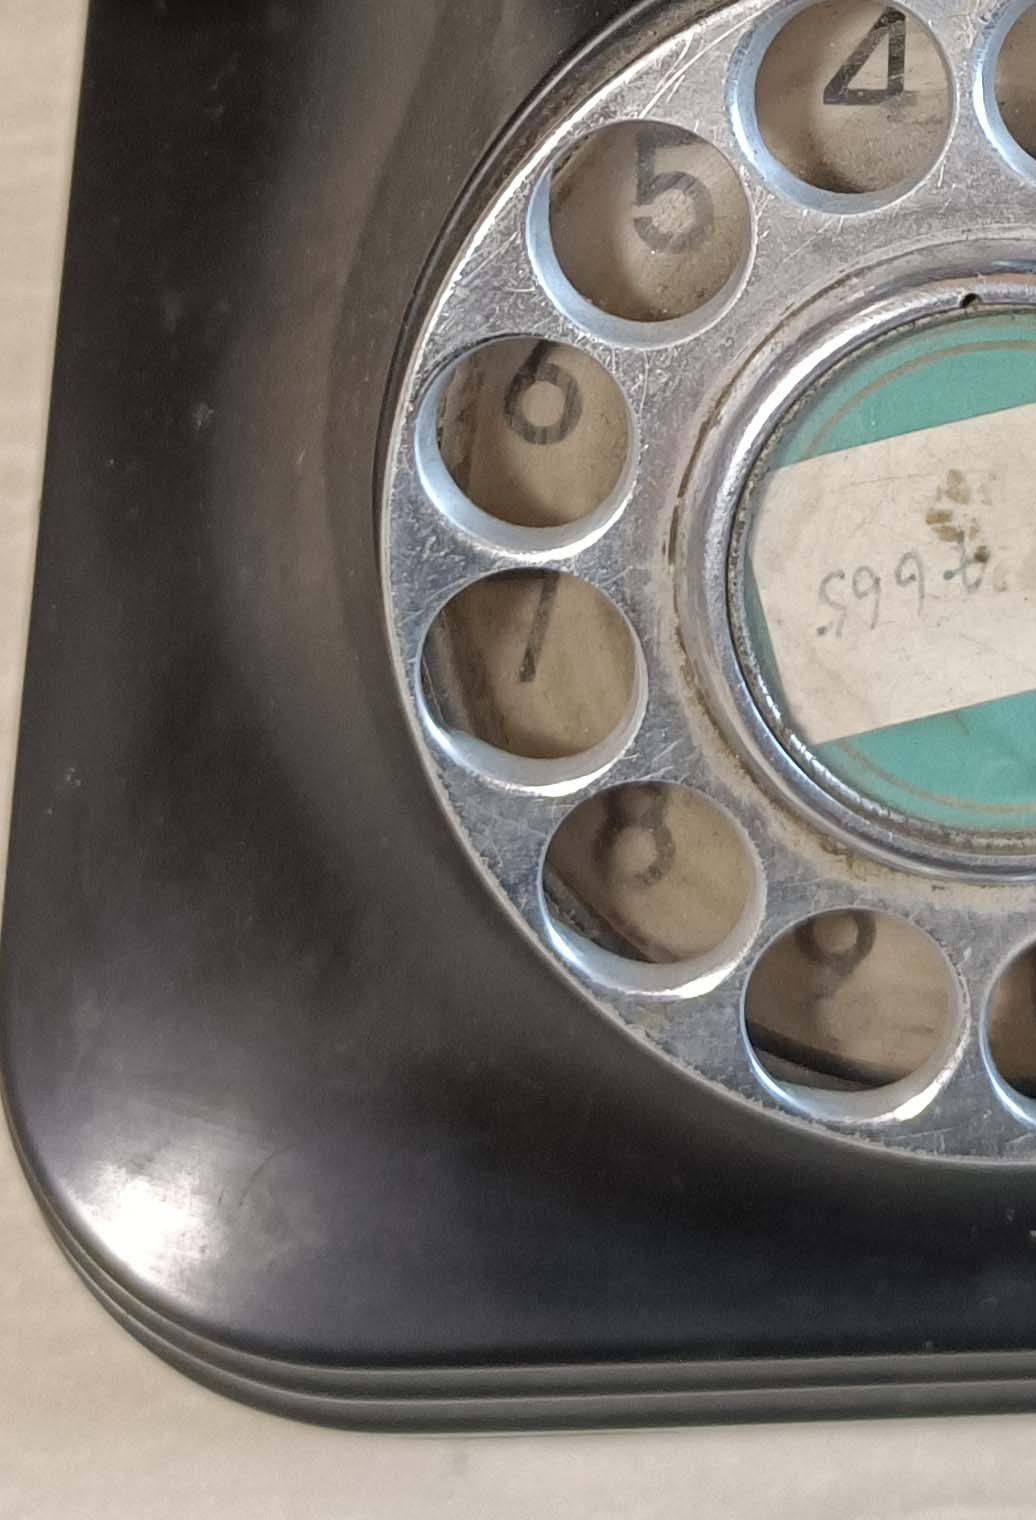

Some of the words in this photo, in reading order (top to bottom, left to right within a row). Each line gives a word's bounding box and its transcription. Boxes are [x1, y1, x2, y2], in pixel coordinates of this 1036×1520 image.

[822, 5, 912, 108] 4
[632, 124, 714, 254] 5
[503, 340, 584, 447] 6
